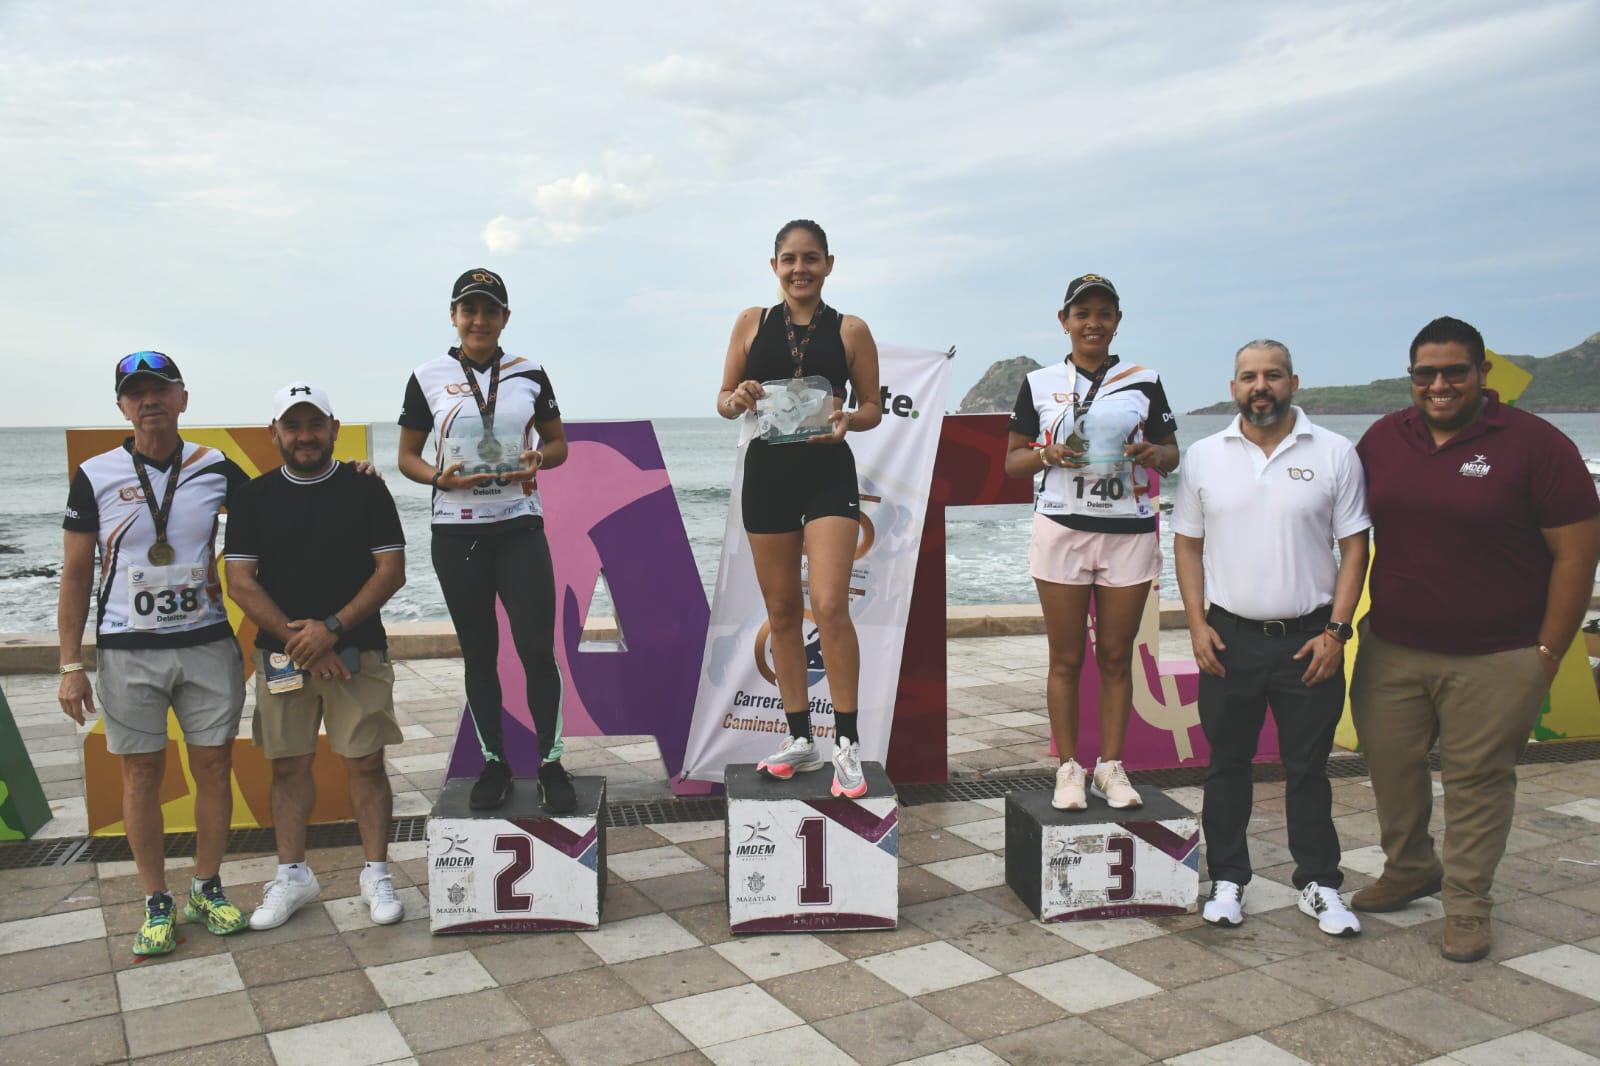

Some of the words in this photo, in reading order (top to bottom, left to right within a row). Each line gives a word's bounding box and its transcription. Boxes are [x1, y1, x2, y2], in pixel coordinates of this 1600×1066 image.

[473, 488, 502, 496] Deloitte
[1072, 476, 1124, 501] 140
[134, 587, 198, 616] 038
[156, 614, 188, 623] Deloitte
[733, 690, 784, 710] Carrera
[722, 713, 788, 734] Caminata
[736, 844, 776, 856] IMDEM
[435, 856, 475, 868] IMDEM
[796, 816, 833, 906] 1
[1050, 856, 1082, 866] IMDEM
[1105, 835, 1137, 903] 3
[493, 833, 534, 914] 2
